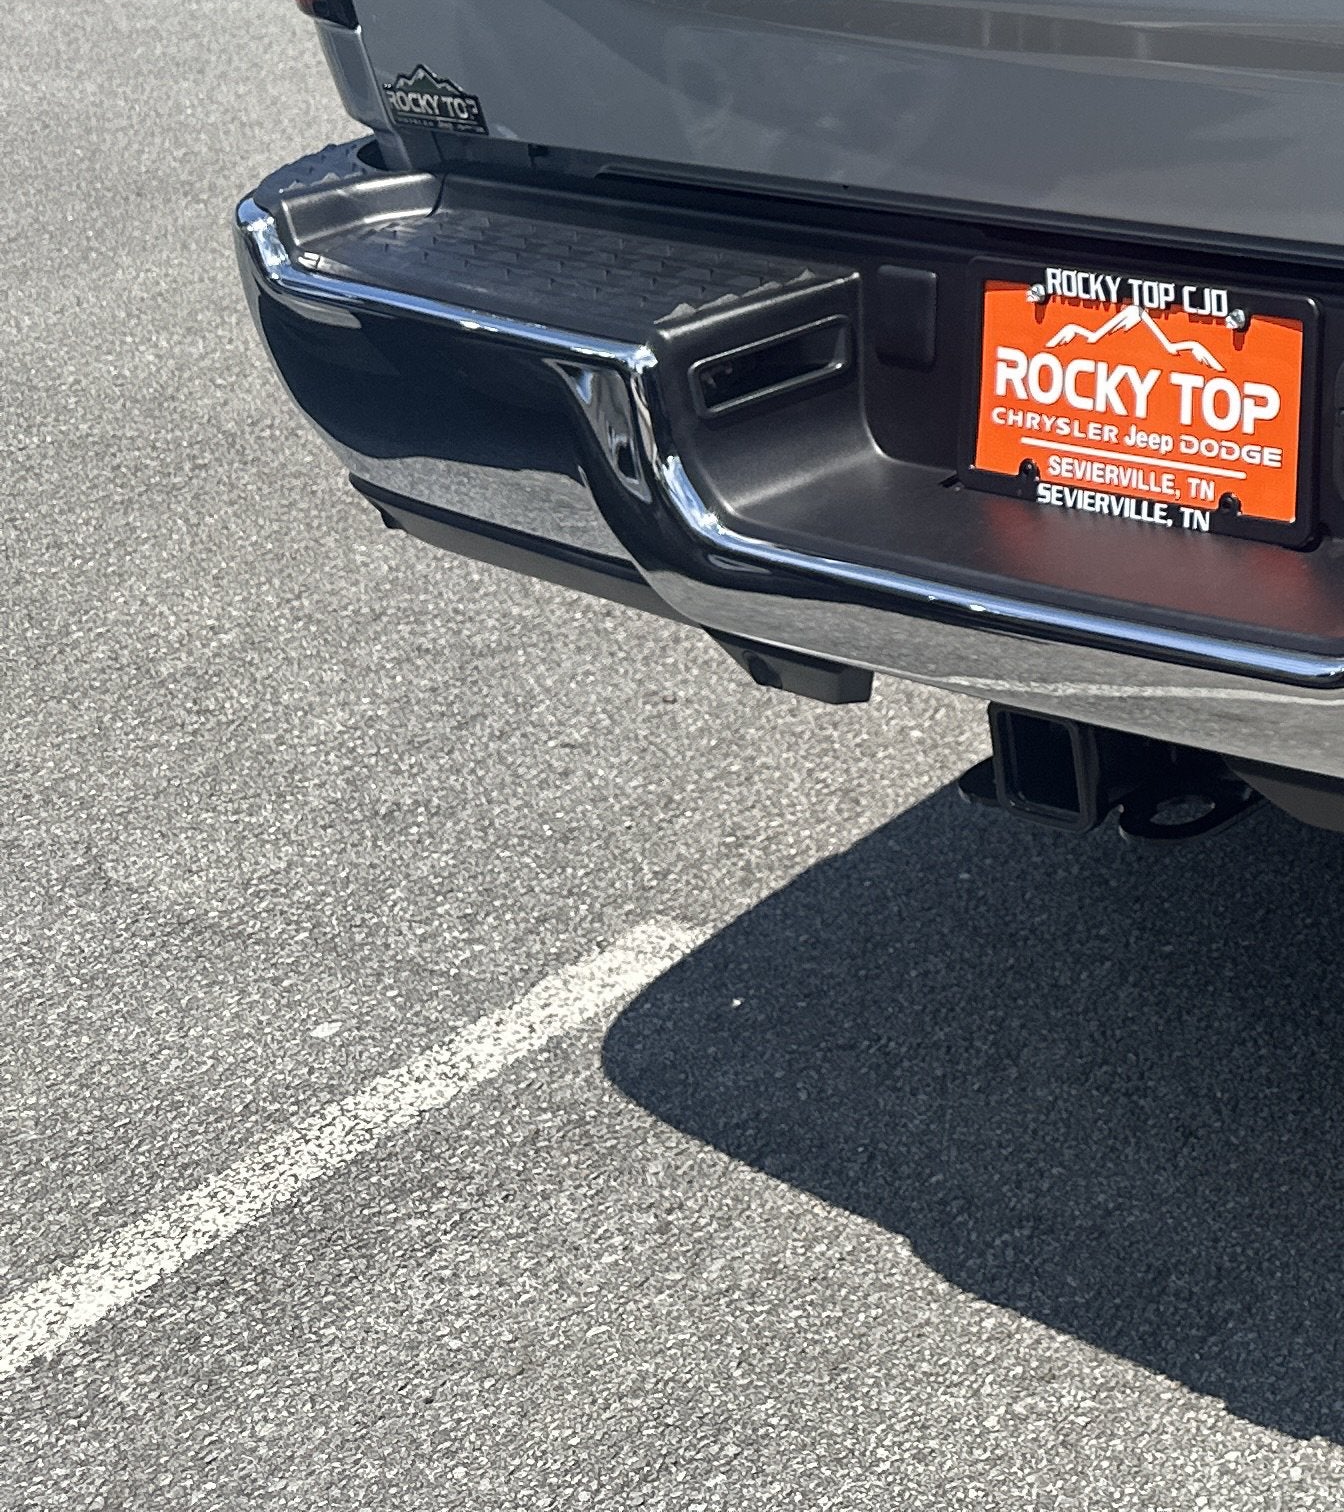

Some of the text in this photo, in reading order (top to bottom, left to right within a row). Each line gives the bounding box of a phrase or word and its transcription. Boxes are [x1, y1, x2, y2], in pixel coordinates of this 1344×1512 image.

[386, 90, 440, 116] ROCKY
[1045, 268, 1122, 304] ROCKY
[1127, 278, 1176, 311] TOP
[995, 345, 1162, 419] ROCKY
[1169, 371, 1281, 435] TOP
[991, 406, 1283, 468] CHRYSLER Jeep DODGE
[1047, 454, 1216, 502] SEVIERVILLE, TN
[1036, 483, 1210, 533] SEVIERVILLE, TN
